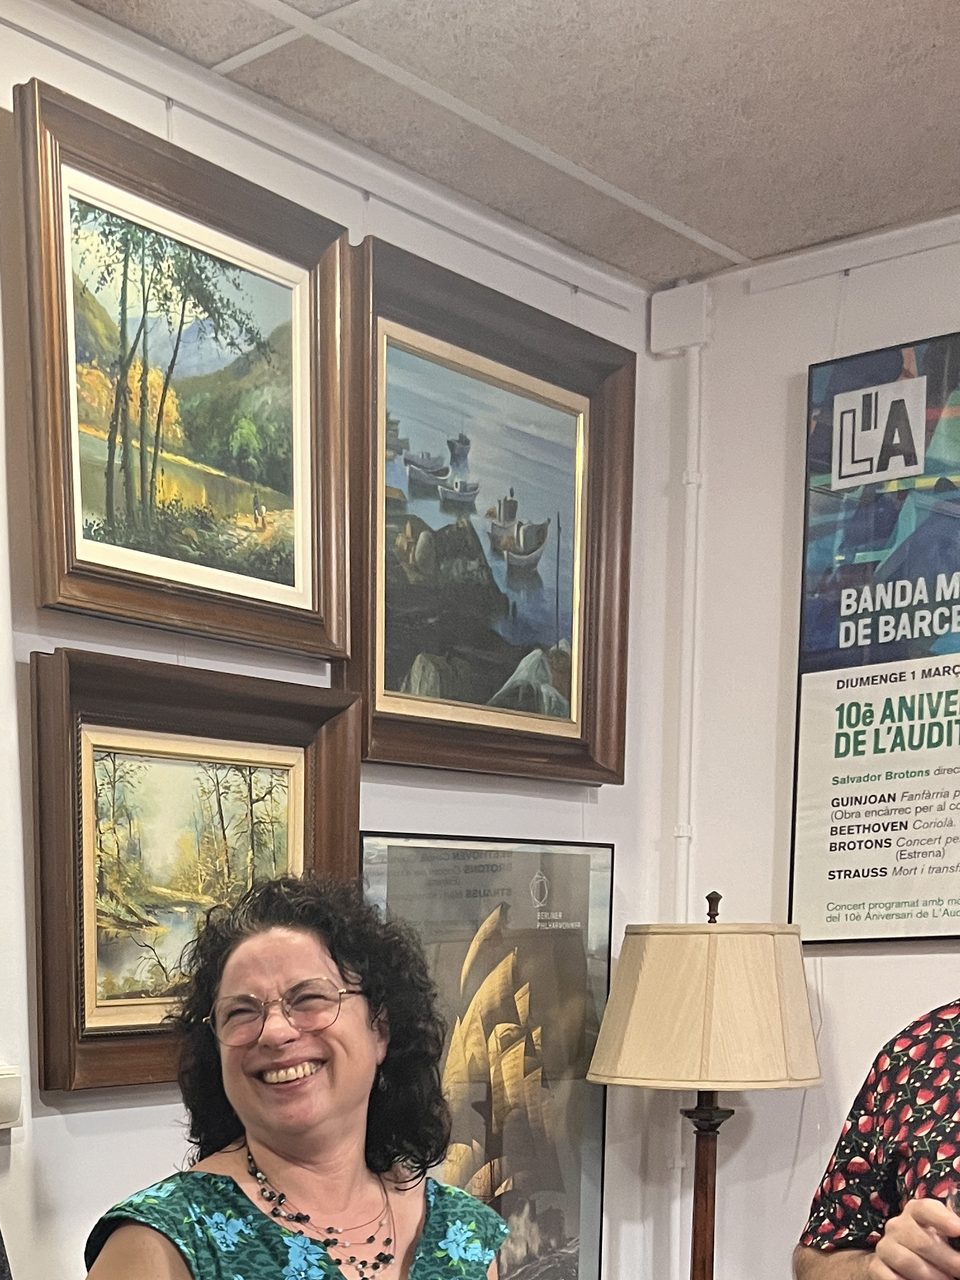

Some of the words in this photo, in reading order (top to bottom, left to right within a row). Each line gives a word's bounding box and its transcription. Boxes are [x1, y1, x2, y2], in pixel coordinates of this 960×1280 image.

[840, 577, 929, 617] BANDA
[839, 618, 872, 649] DE
[836, 672, 907, 690] DIUMENGE
[910, 671, 917, 681] 1
[880, 689, 960, 725] ANIVE
[834, 730, 867, 759] DE
[831, 773, 882, 786] Salvador
[885, 769, 931, 781] Brotons
[831, 793, 897, 808] GUINJOAN
[900, 788, 950, 802] Fanfàrria
[830, 808, 861, 823] (Obra
[864, 806, 912, 818] encàrrec
[914, 805, 934, 816] per
[936, 802, 946, 812] al
[830, 821, 909, 836] BEETHOVEN
[829, 838, 892, 852] BROTONS
[896, 836, 942, 848] Concert
[944, 836, 960, 848] pe
[895, 848, 946, 862] (Estrena)
[828, 867, 888, 880] STRAUSS
[892, 866, 918, 877] Mort
[928, 863, 960, 875] transf
[826, 902, 866, 912] Concert
[868, 899, 920, 911] programat
[922, 897, 945, 907] amb
[826, 914, 841, 923] del
[864, 912, 913, 921] Aniversari
[916, 908, 929, 918] de
